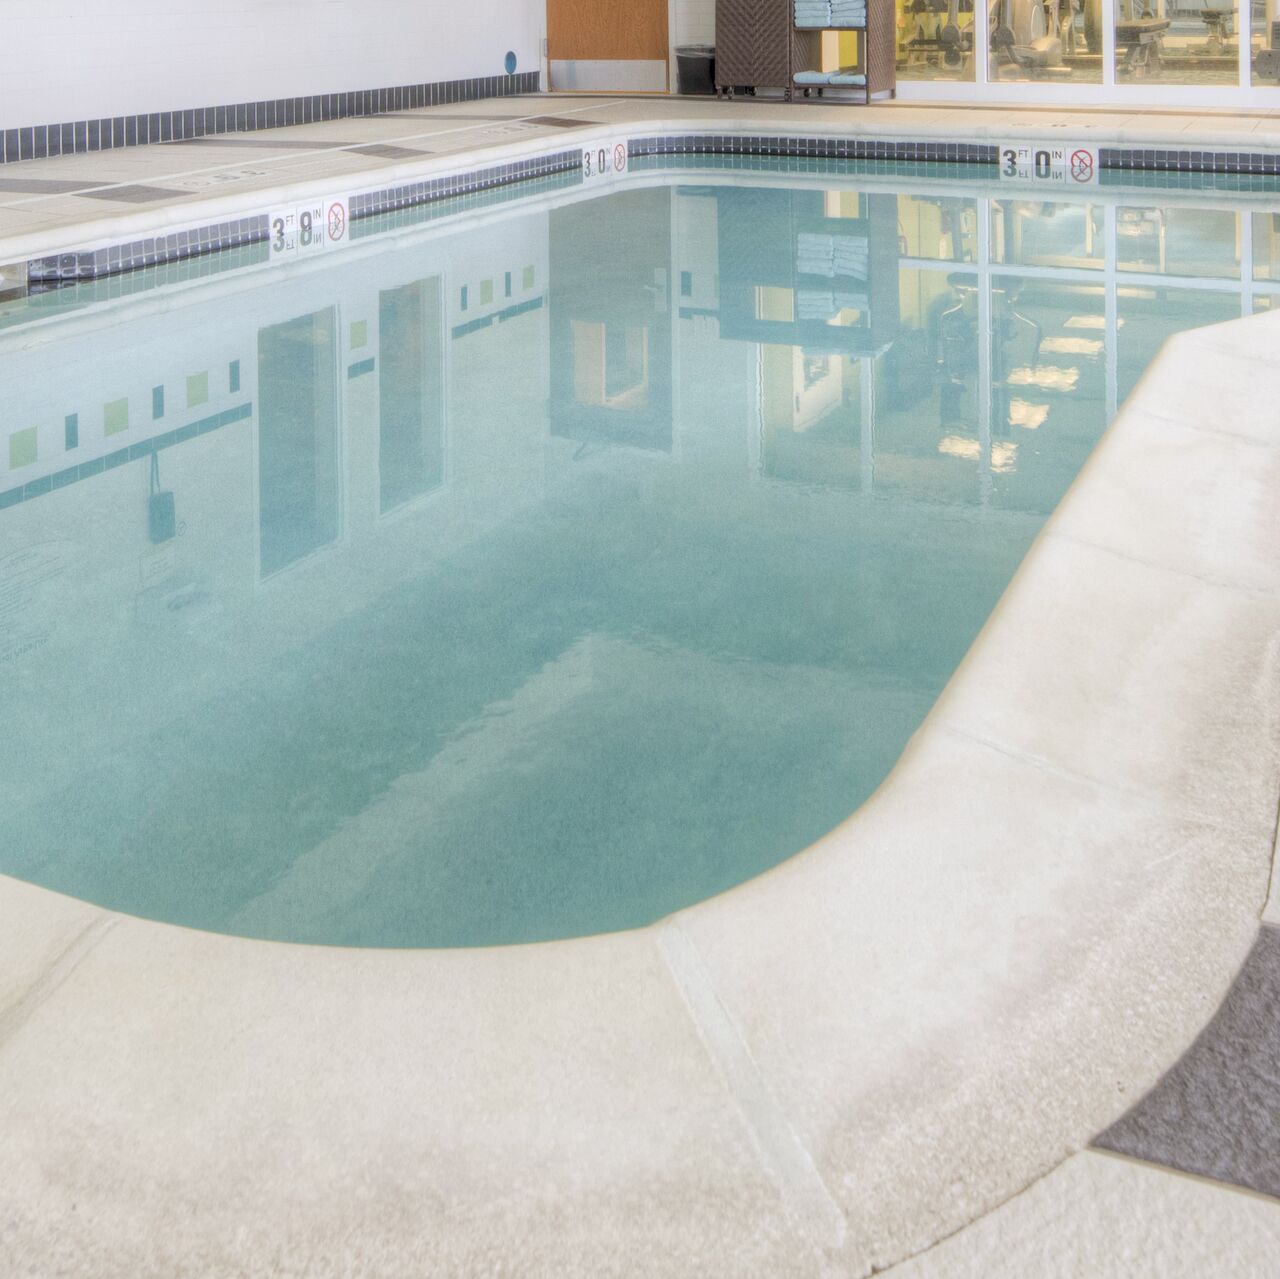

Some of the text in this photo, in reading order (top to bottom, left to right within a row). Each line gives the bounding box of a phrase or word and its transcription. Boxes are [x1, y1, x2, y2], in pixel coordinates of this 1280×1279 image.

[1003, 149, 1017, 166] 3
[1018, 150, 1029, 159] FT
[1051, 151, 1062, 159] IN
[272, 217, 285, 237] 3
[286, 214, 295, 226] FT
[313, 208, 321, 220] IN
